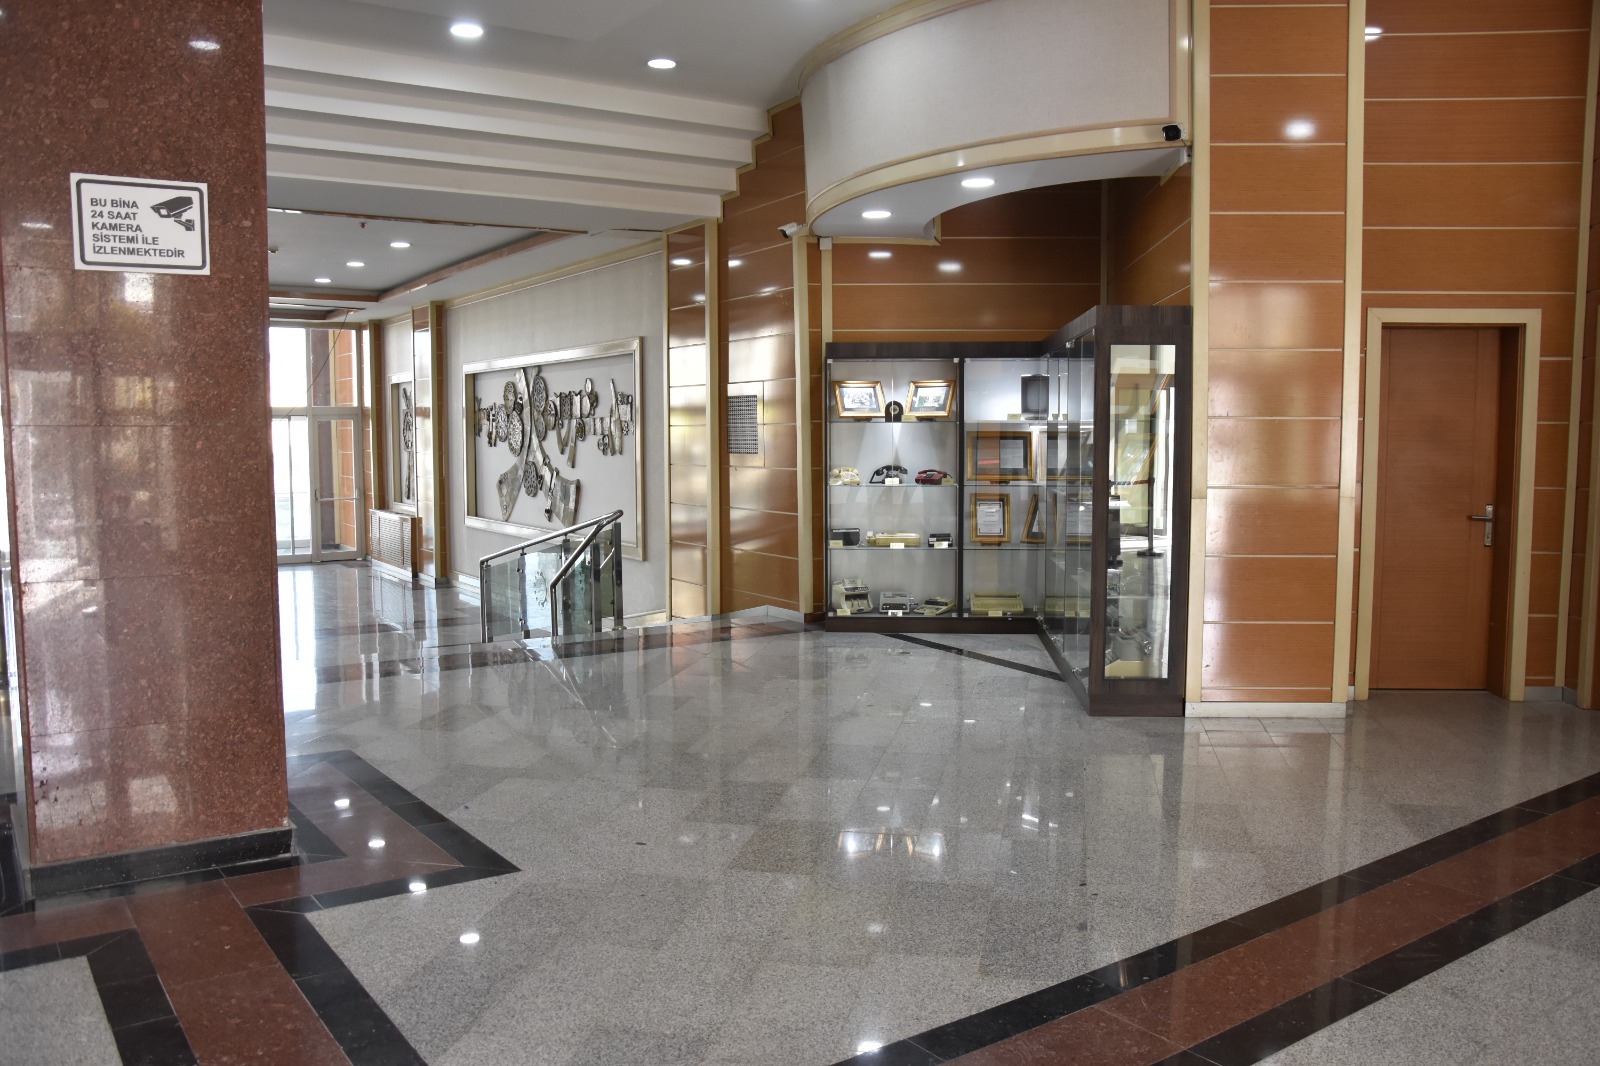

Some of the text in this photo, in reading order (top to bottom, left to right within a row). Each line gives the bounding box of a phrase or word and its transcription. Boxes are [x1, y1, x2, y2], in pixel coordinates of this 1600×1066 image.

[90, 198, 139, 209] BU BİNA
[91, 210, 138, 221] 24 SAAT
[91, 222, 143, 233] KAMERA
[92, 232, 159, 245] SİSTEMİ İLE
[92, 243, 185, 258] İZLENMEKTEDİR
